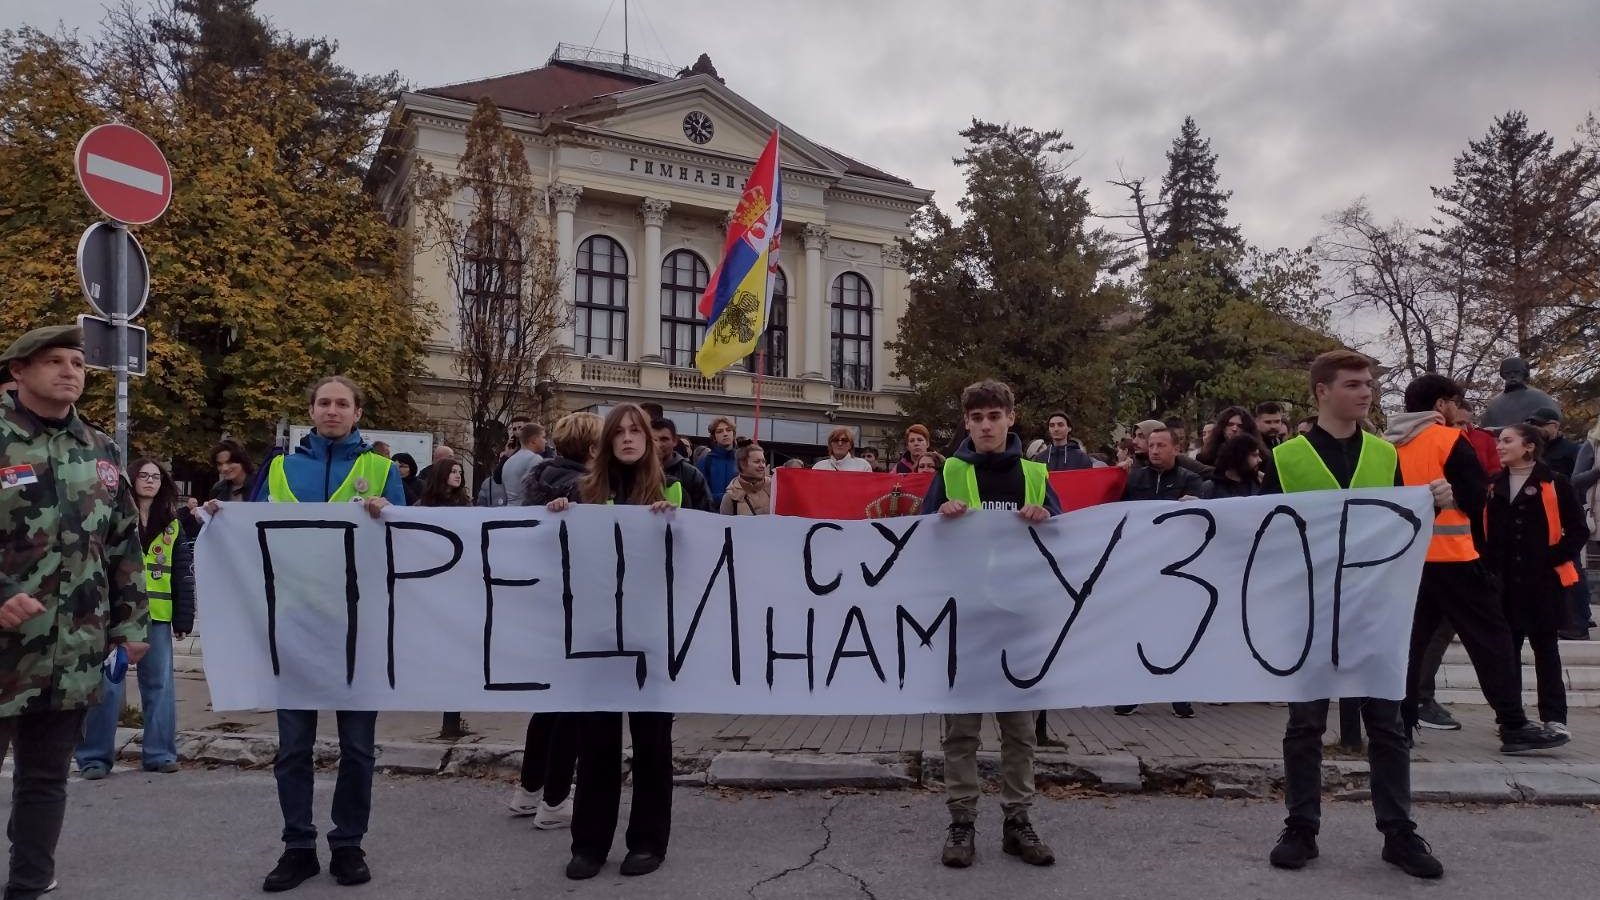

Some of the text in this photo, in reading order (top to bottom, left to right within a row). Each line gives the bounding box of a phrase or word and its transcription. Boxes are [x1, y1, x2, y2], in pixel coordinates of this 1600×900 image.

[256, 499, 1421, 692] ПРЕЦИ СУ НАМ УЗОР
